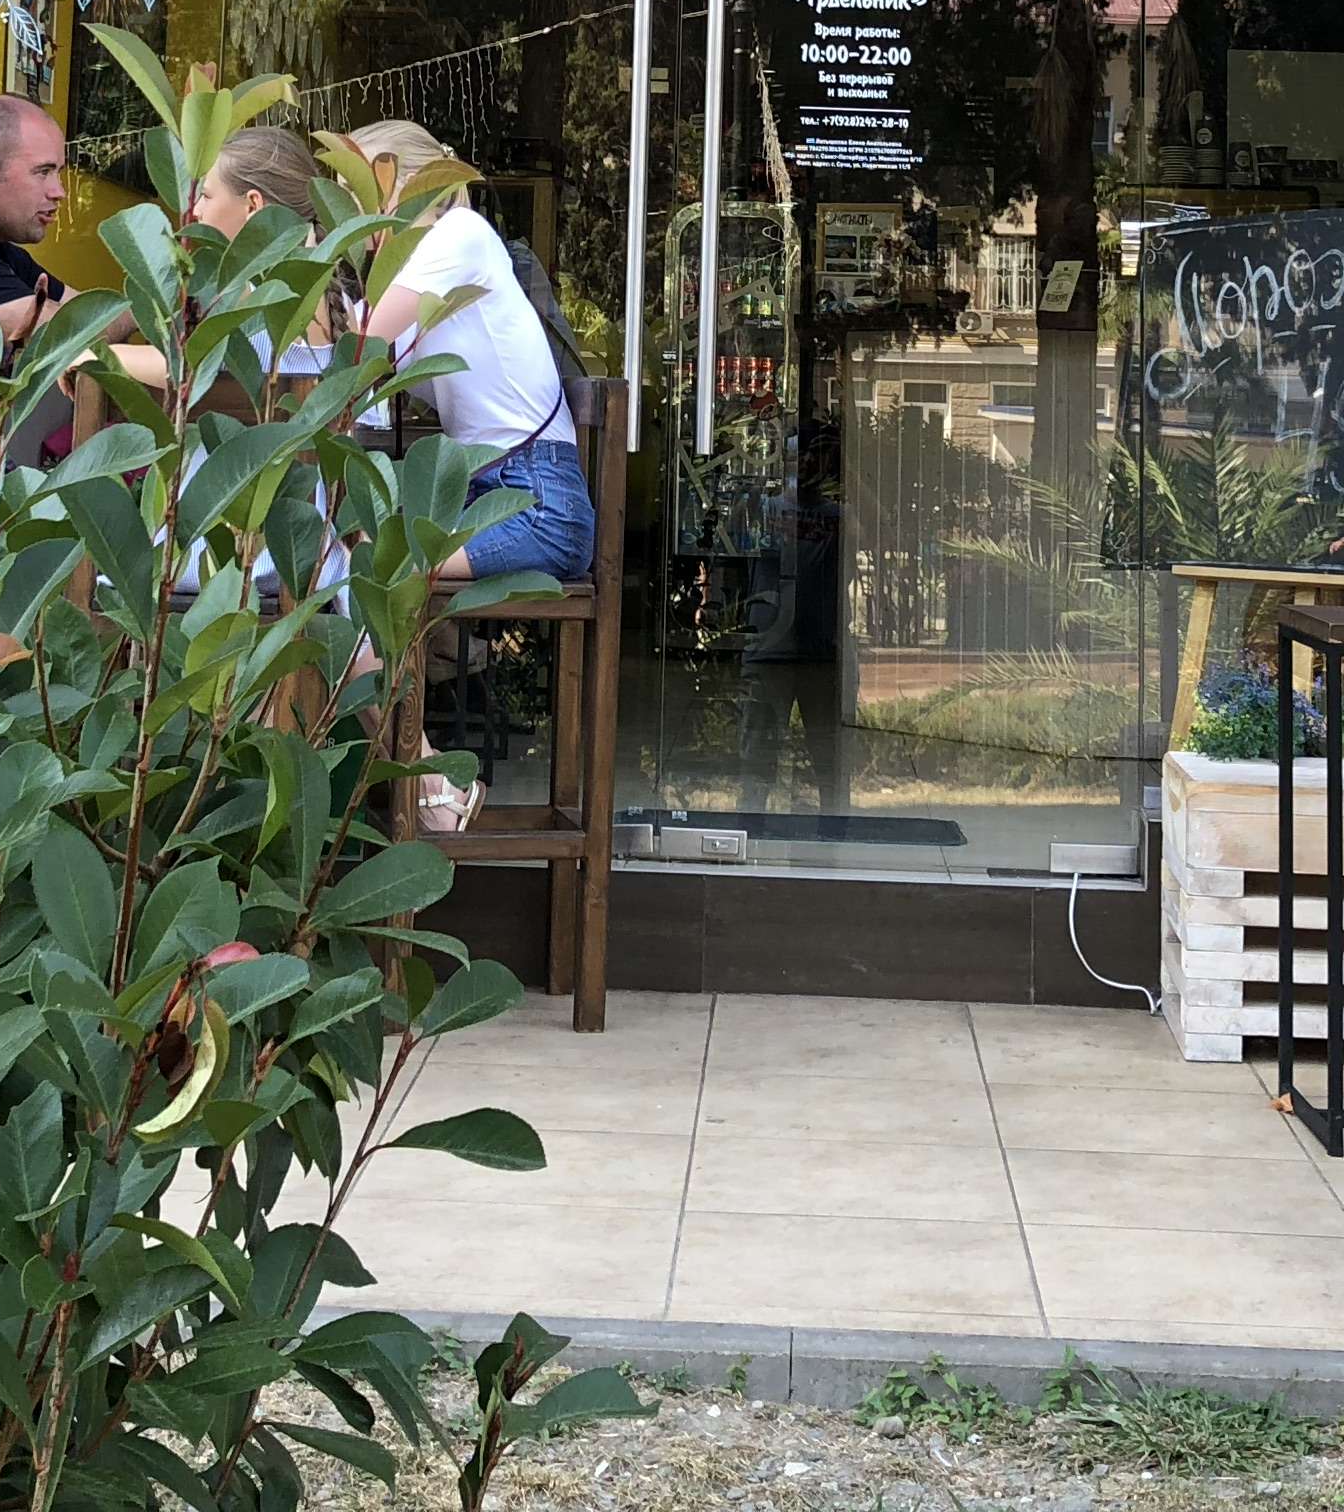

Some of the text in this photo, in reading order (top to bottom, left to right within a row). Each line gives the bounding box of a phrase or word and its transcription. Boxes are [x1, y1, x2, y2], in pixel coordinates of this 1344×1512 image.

[814, 22, 901, 40] Время работы:
[818, 70, 894, 86] Без перерывов
[827, 89, 888, 99] и выходных
